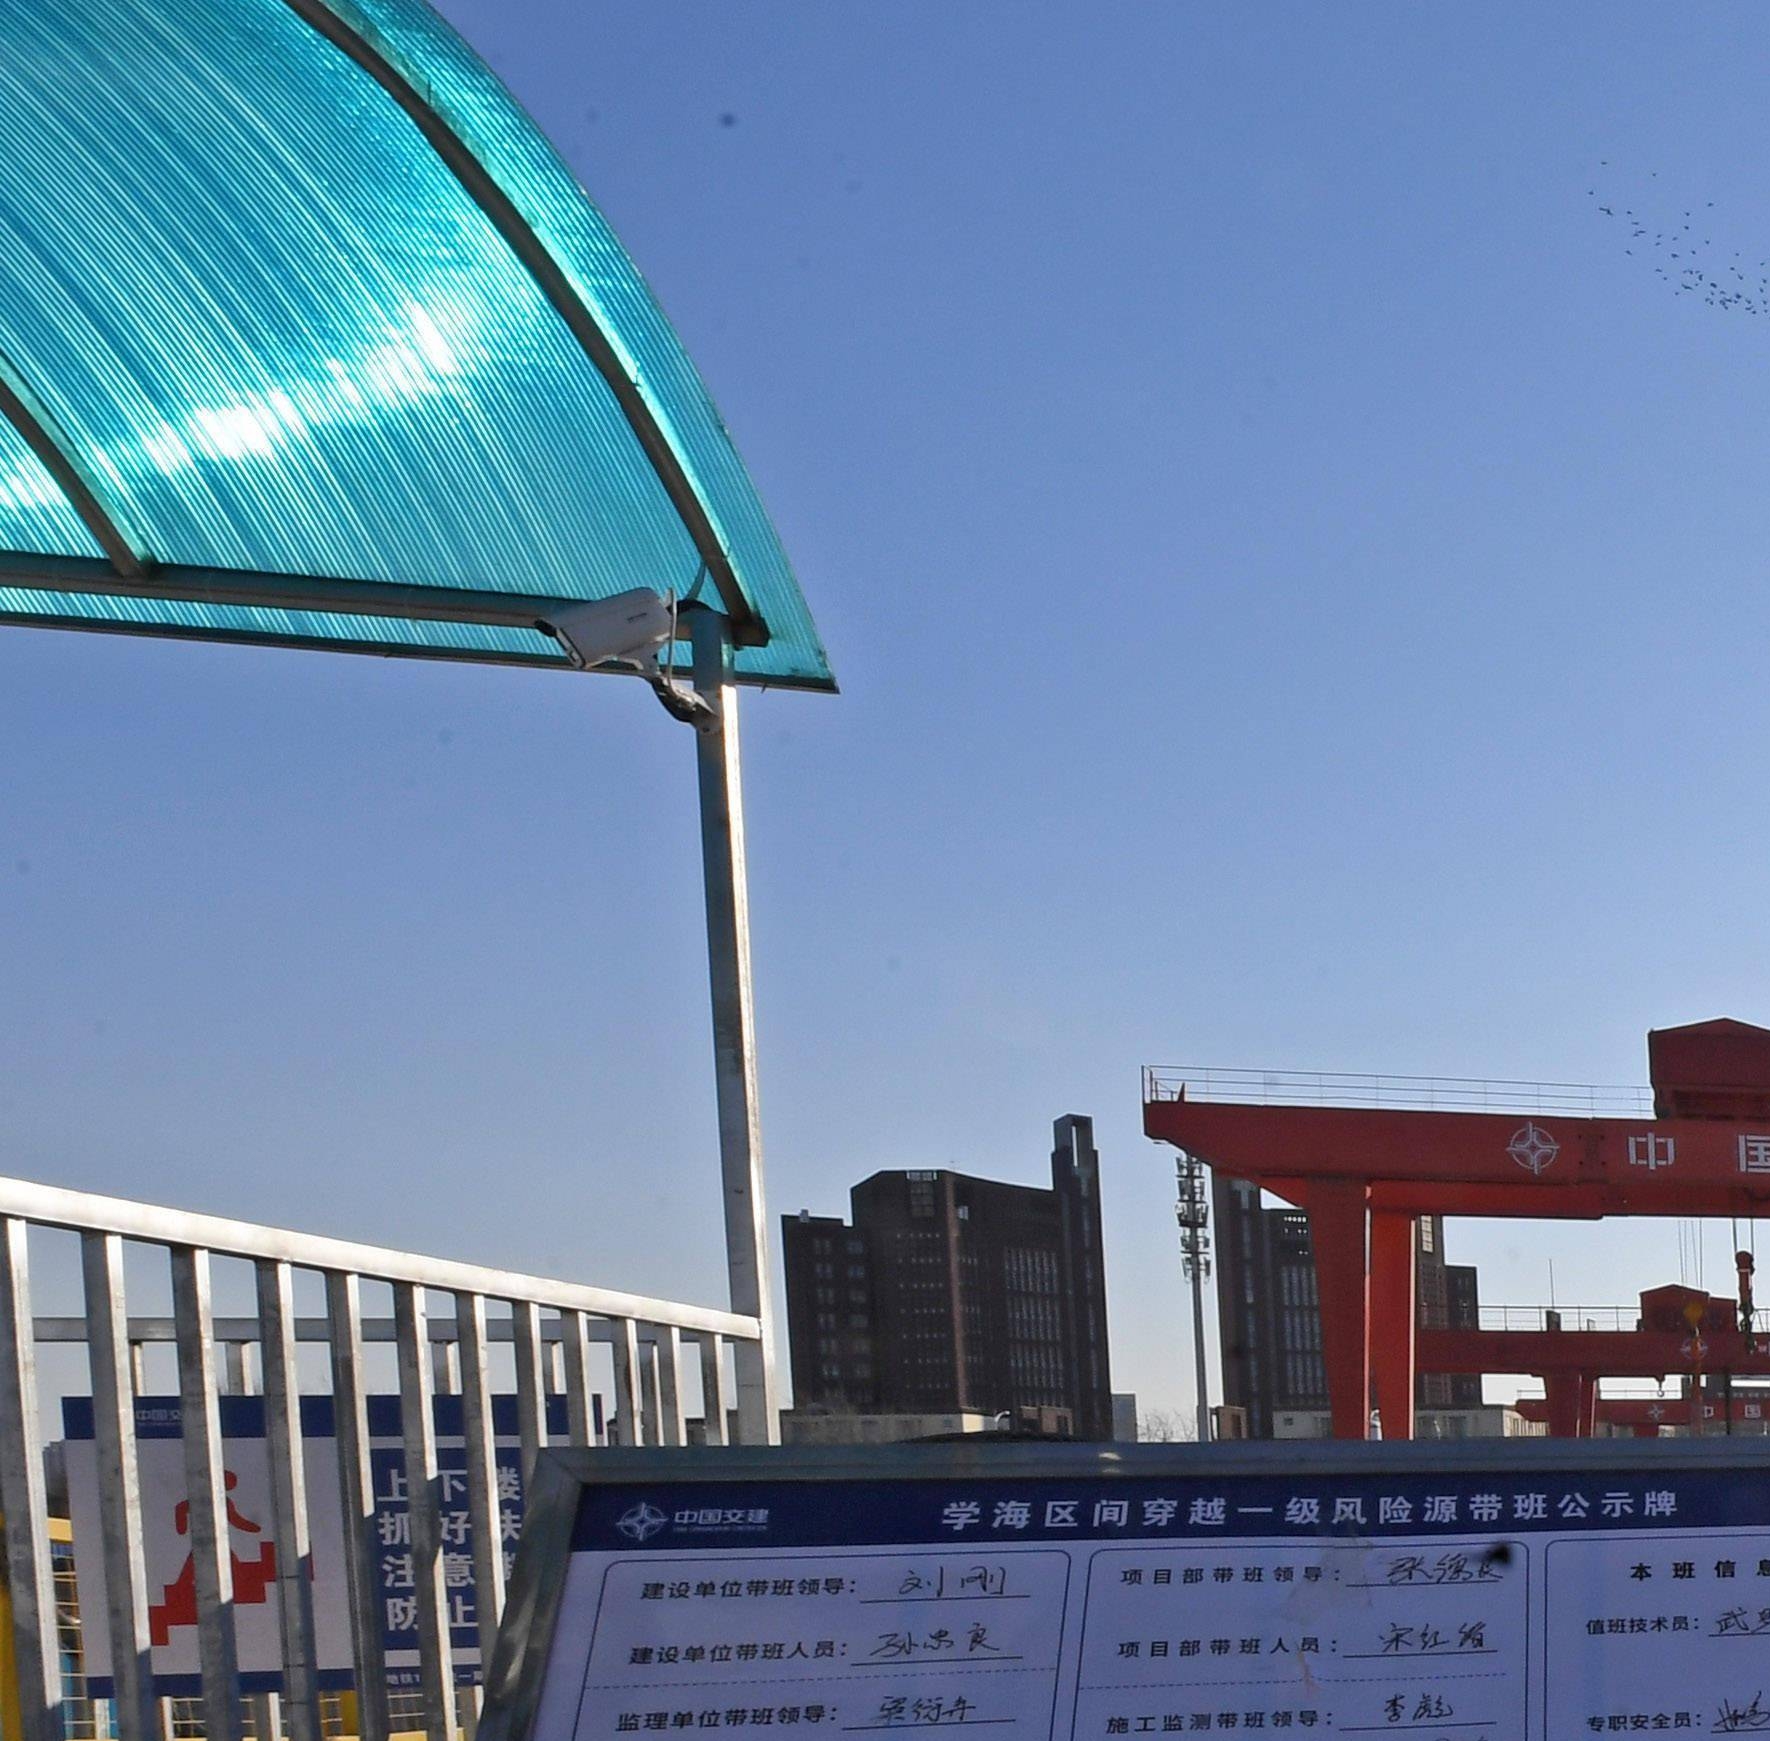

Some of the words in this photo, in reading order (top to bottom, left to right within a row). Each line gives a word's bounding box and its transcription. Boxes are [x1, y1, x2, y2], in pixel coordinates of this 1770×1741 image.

[941, 1490, 1678, 1531] 学海区间穿越一级风险源带班公示牌
[639, 1575, 858, 1601] 建设单位带班领导：
[1119, 1564, 1342, 1587] 项目部带班领导：
[627, 1639, 850, 1666] 建设单位带班人员：
[1116, 1635, 1340, 1660] 项目部带班人员：
[614, 1704, 838, 1733] 监理单位带班领导：
[1105, 1709, 1335, 1735] 施工监测带班领导：
